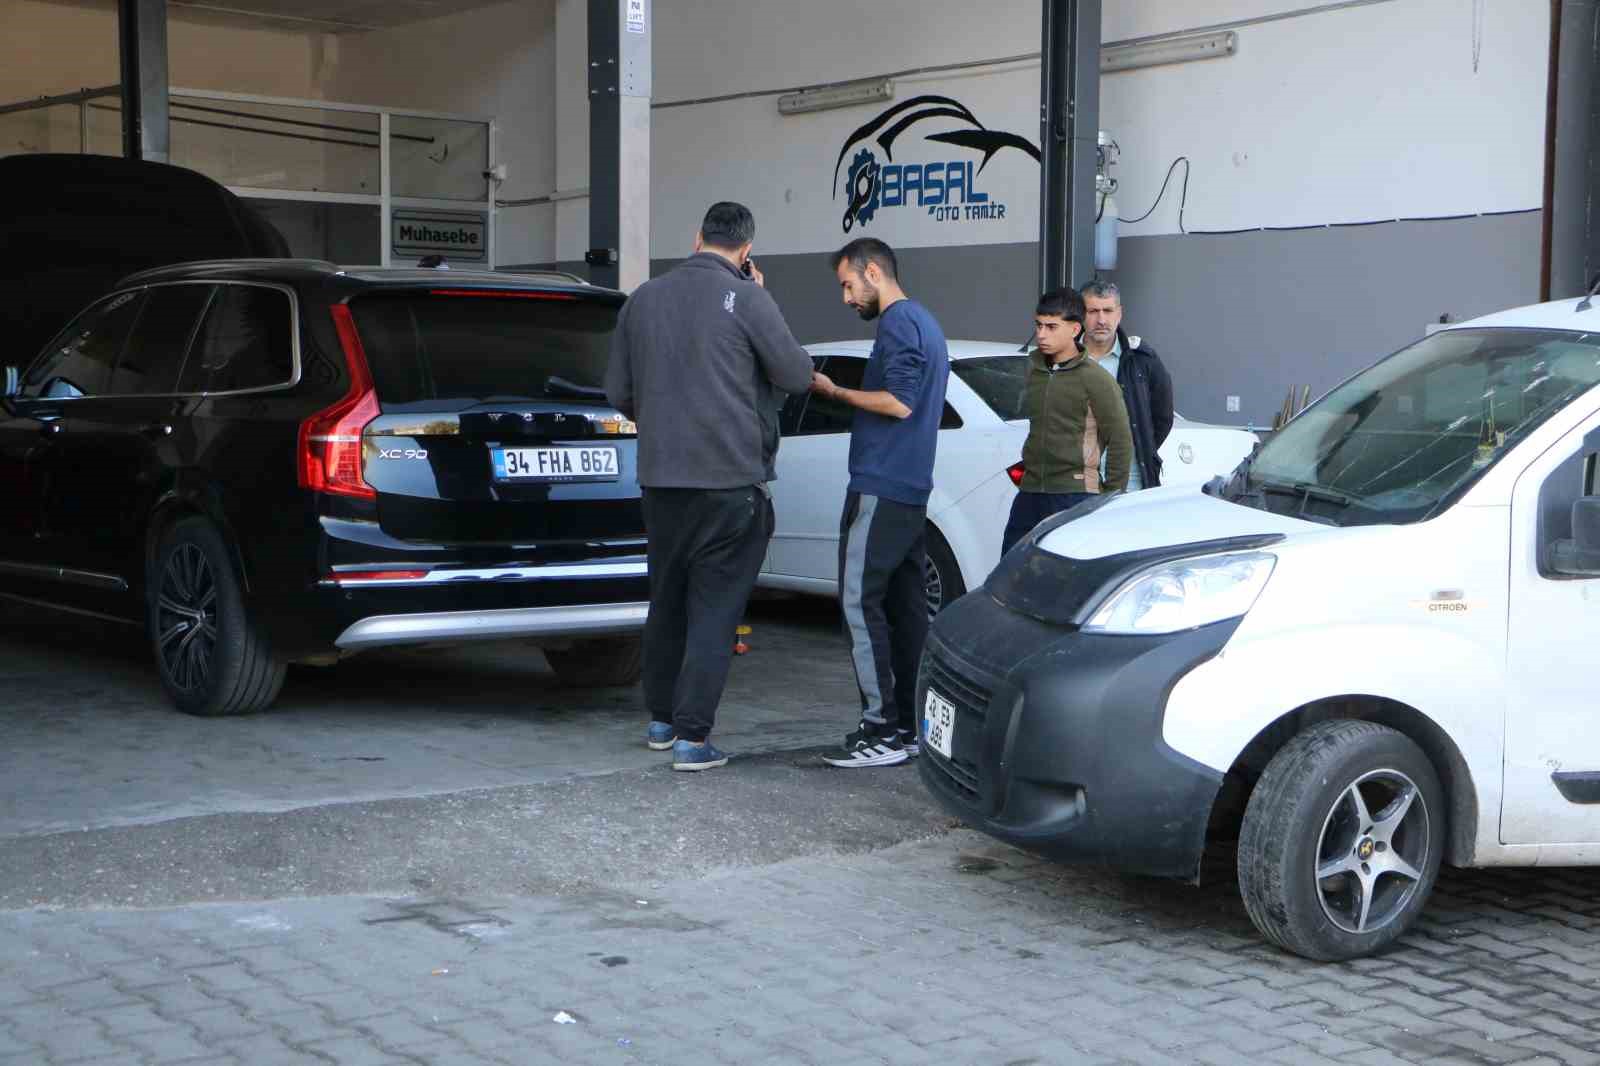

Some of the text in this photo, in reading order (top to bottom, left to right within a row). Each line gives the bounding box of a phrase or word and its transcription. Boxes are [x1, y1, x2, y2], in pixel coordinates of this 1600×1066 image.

[881, 160, 988, 207] BASAL
[936, 206, 959, 222] OTO
[400, 225, 478, 244] Muhasebe
[506, 451, 530, 474] 34
[537, 450, 573, 474] FHA
[580, 450, 615, 473] 862
